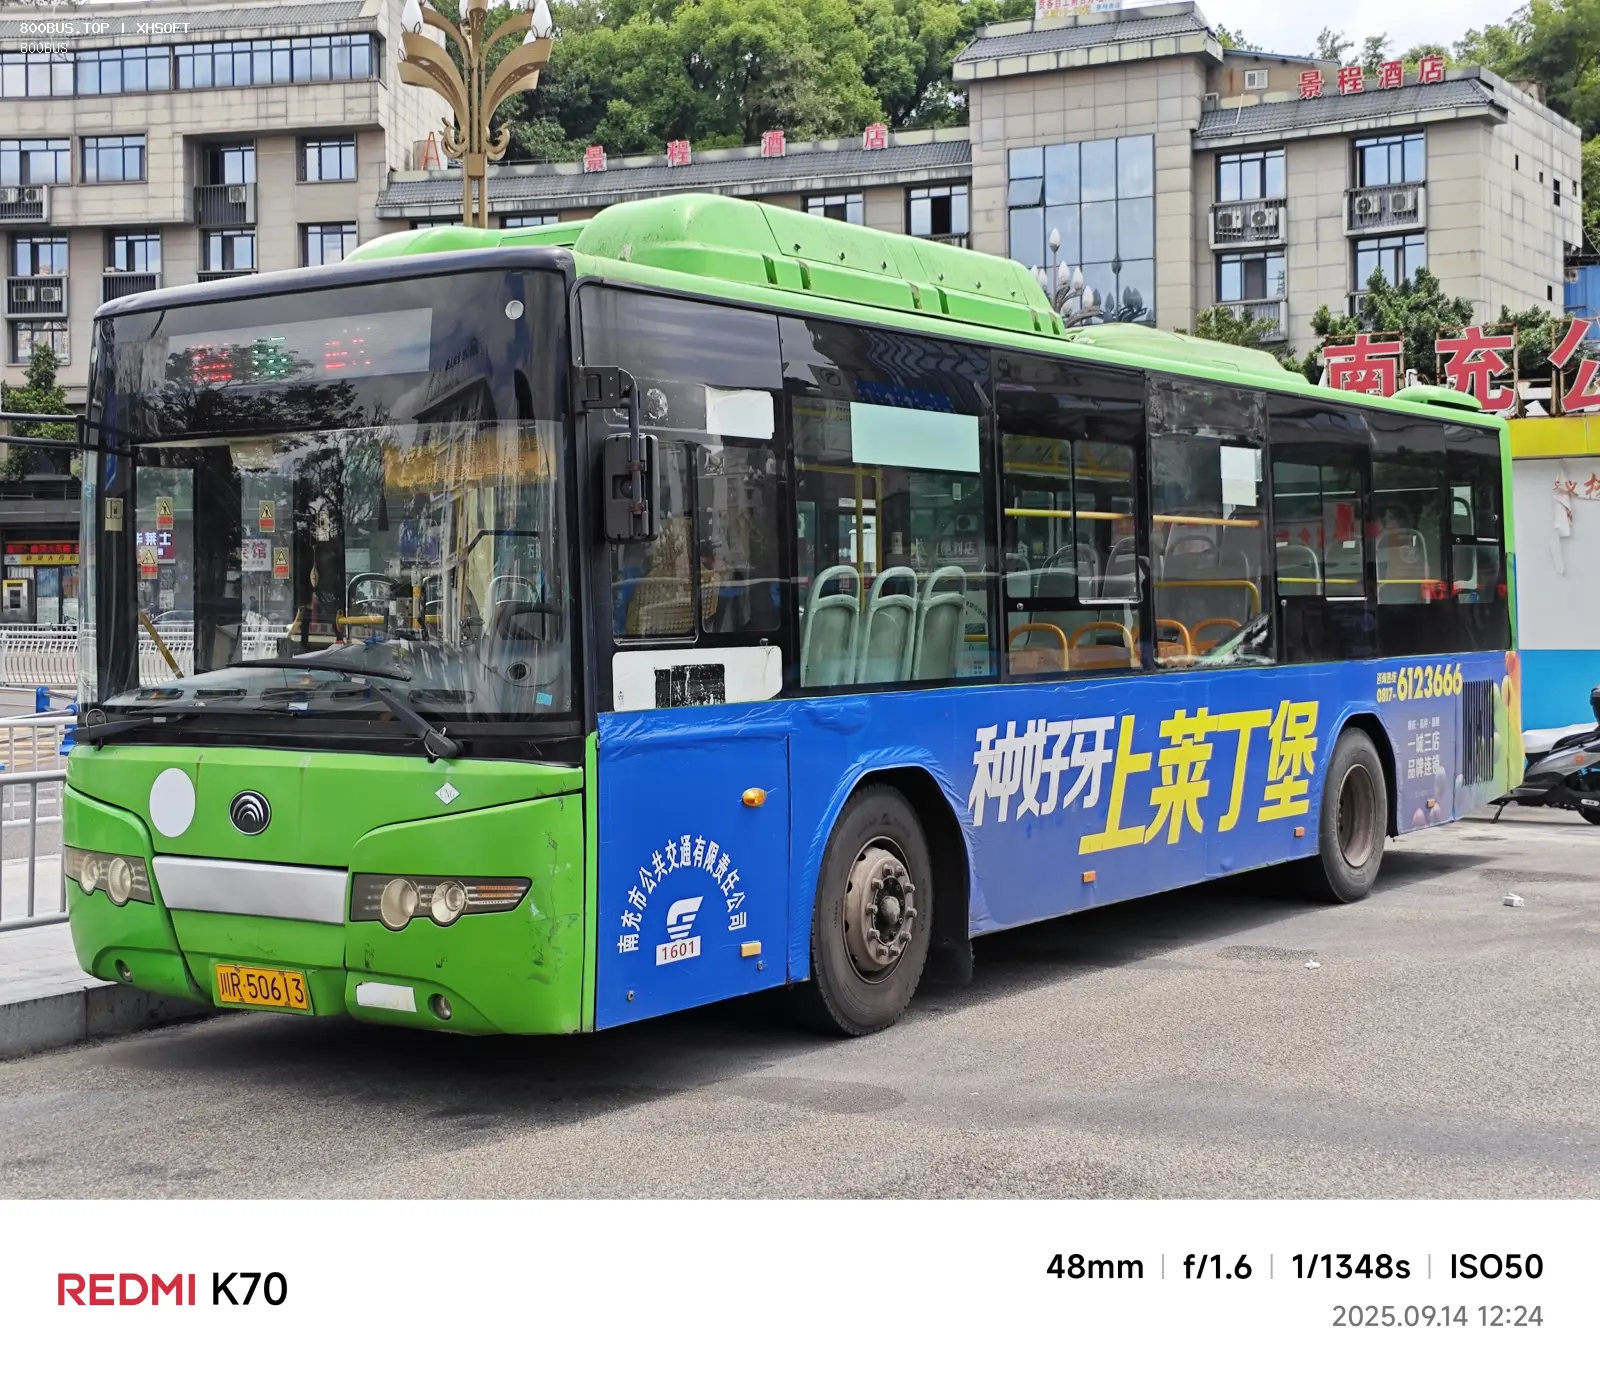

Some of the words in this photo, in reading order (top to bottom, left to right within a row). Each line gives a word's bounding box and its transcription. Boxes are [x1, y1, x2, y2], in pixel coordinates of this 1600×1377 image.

[1298, 54, 1445, 99] 景程酒店
[586, 122, 889, 172] 景程酒店
[1397, 663, 1463, 701] 6123666
[968, 715, 1115, 827] 种好牙
[1078, 700, 1320, 855] 上莱丁堡
[617, 834, 747, 953] 南充市公共交通有限责任公司
[661, 940, 696, 961] 1601
